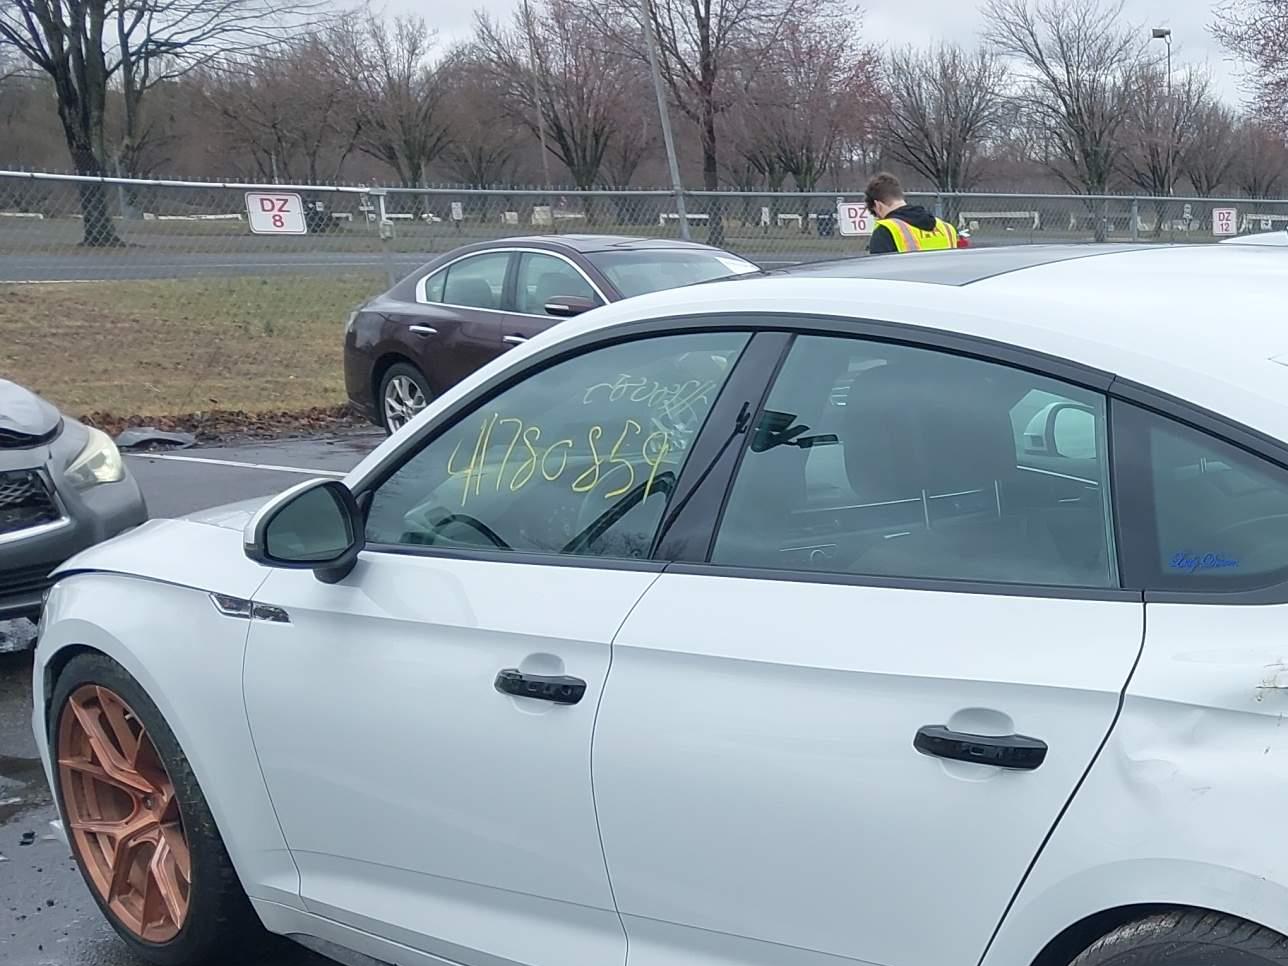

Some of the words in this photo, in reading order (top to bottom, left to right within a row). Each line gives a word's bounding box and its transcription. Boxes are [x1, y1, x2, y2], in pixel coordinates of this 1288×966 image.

[259, 198, 291, 213] DZ
[847, 207, 868, 219] DZ
[1218, 211, 1232, 222] DZ
[272, 214, 284, 228] 8
[851, 220, 866, 231] 10
[1219, 222, 1231, 233] 12
[447, 412, 669, 506] 41780859
